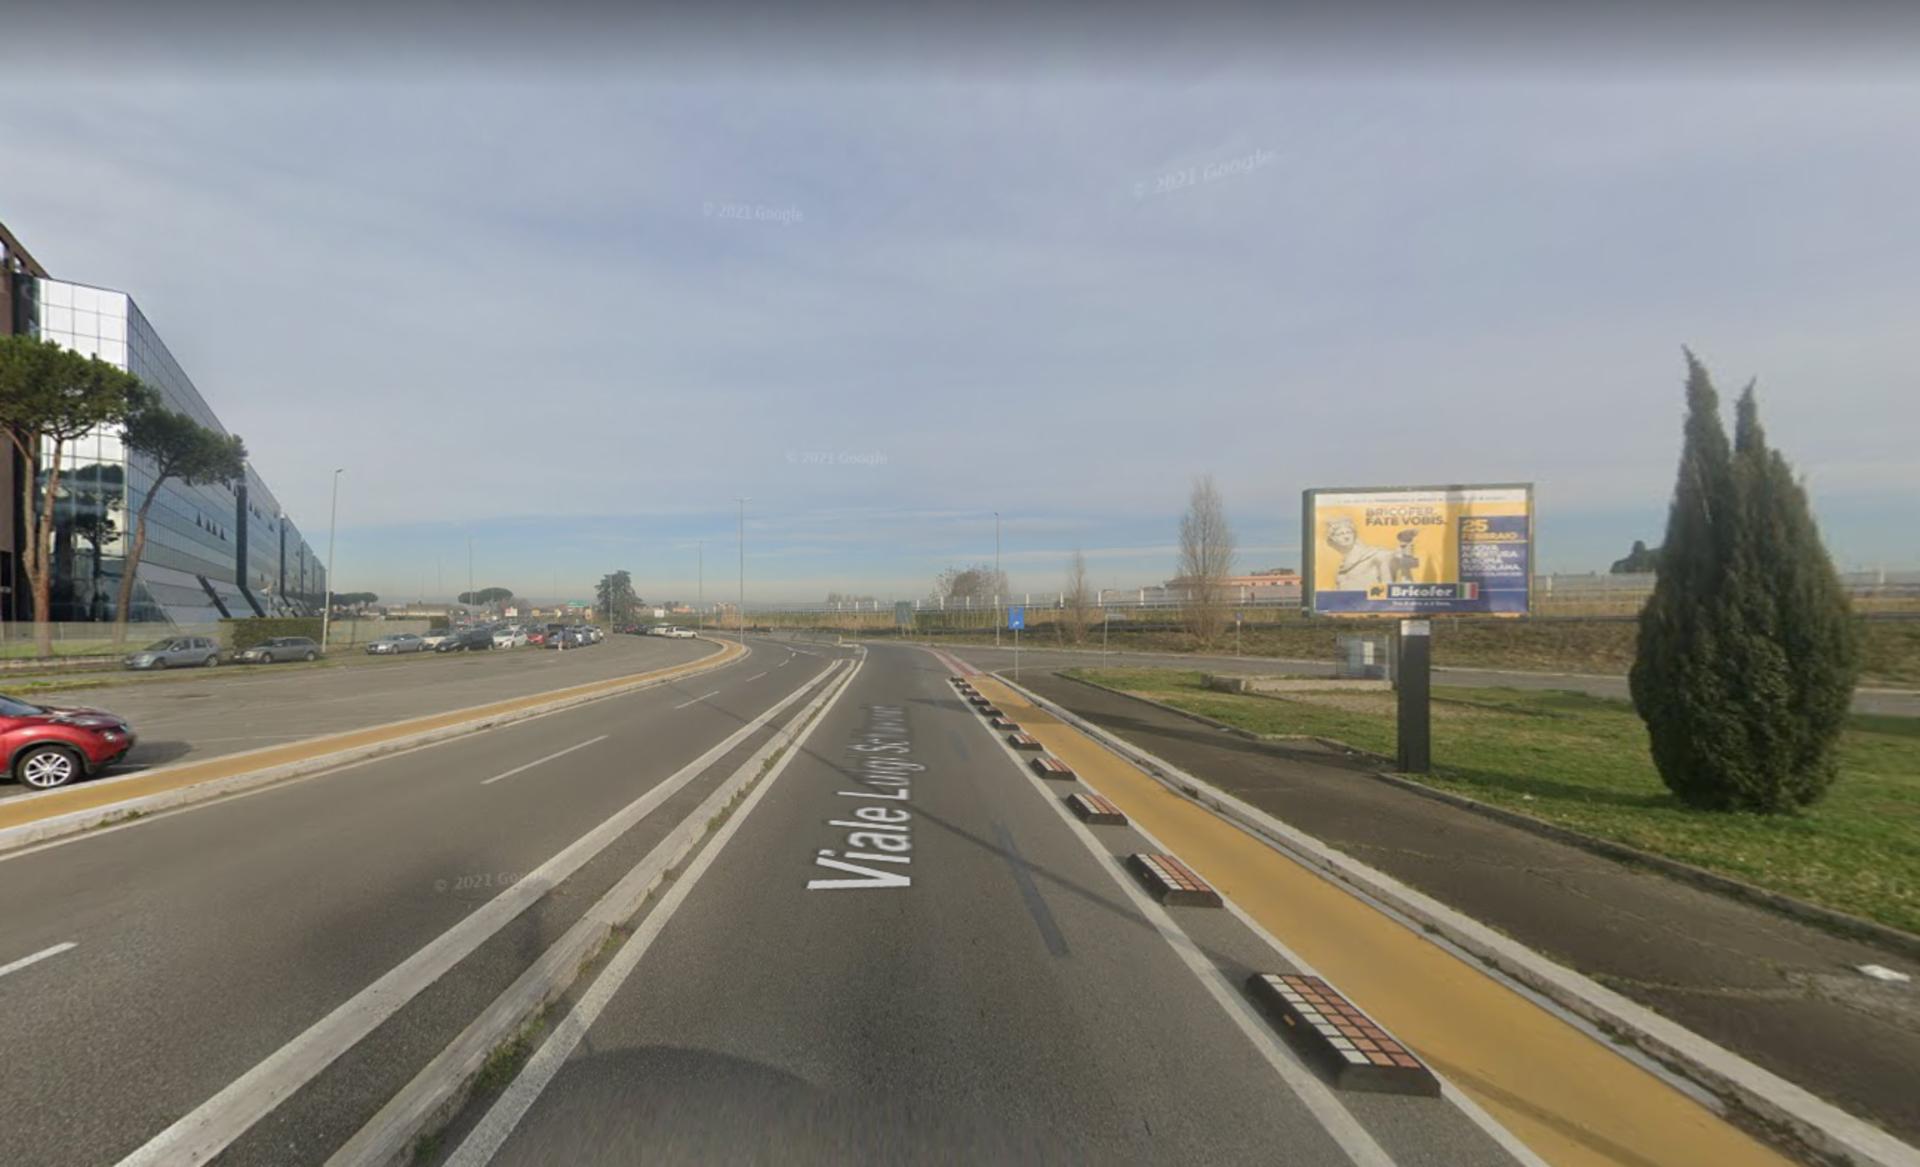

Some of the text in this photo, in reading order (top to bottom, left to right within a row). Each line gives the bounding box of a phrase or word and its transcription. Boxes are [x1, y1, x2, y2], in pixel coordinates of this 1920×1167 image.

[1366, 516, 1399, 526] FATE
[1463, 519, 1488, 532] 25
[1391, 585, 1453, 597] Bricofer
